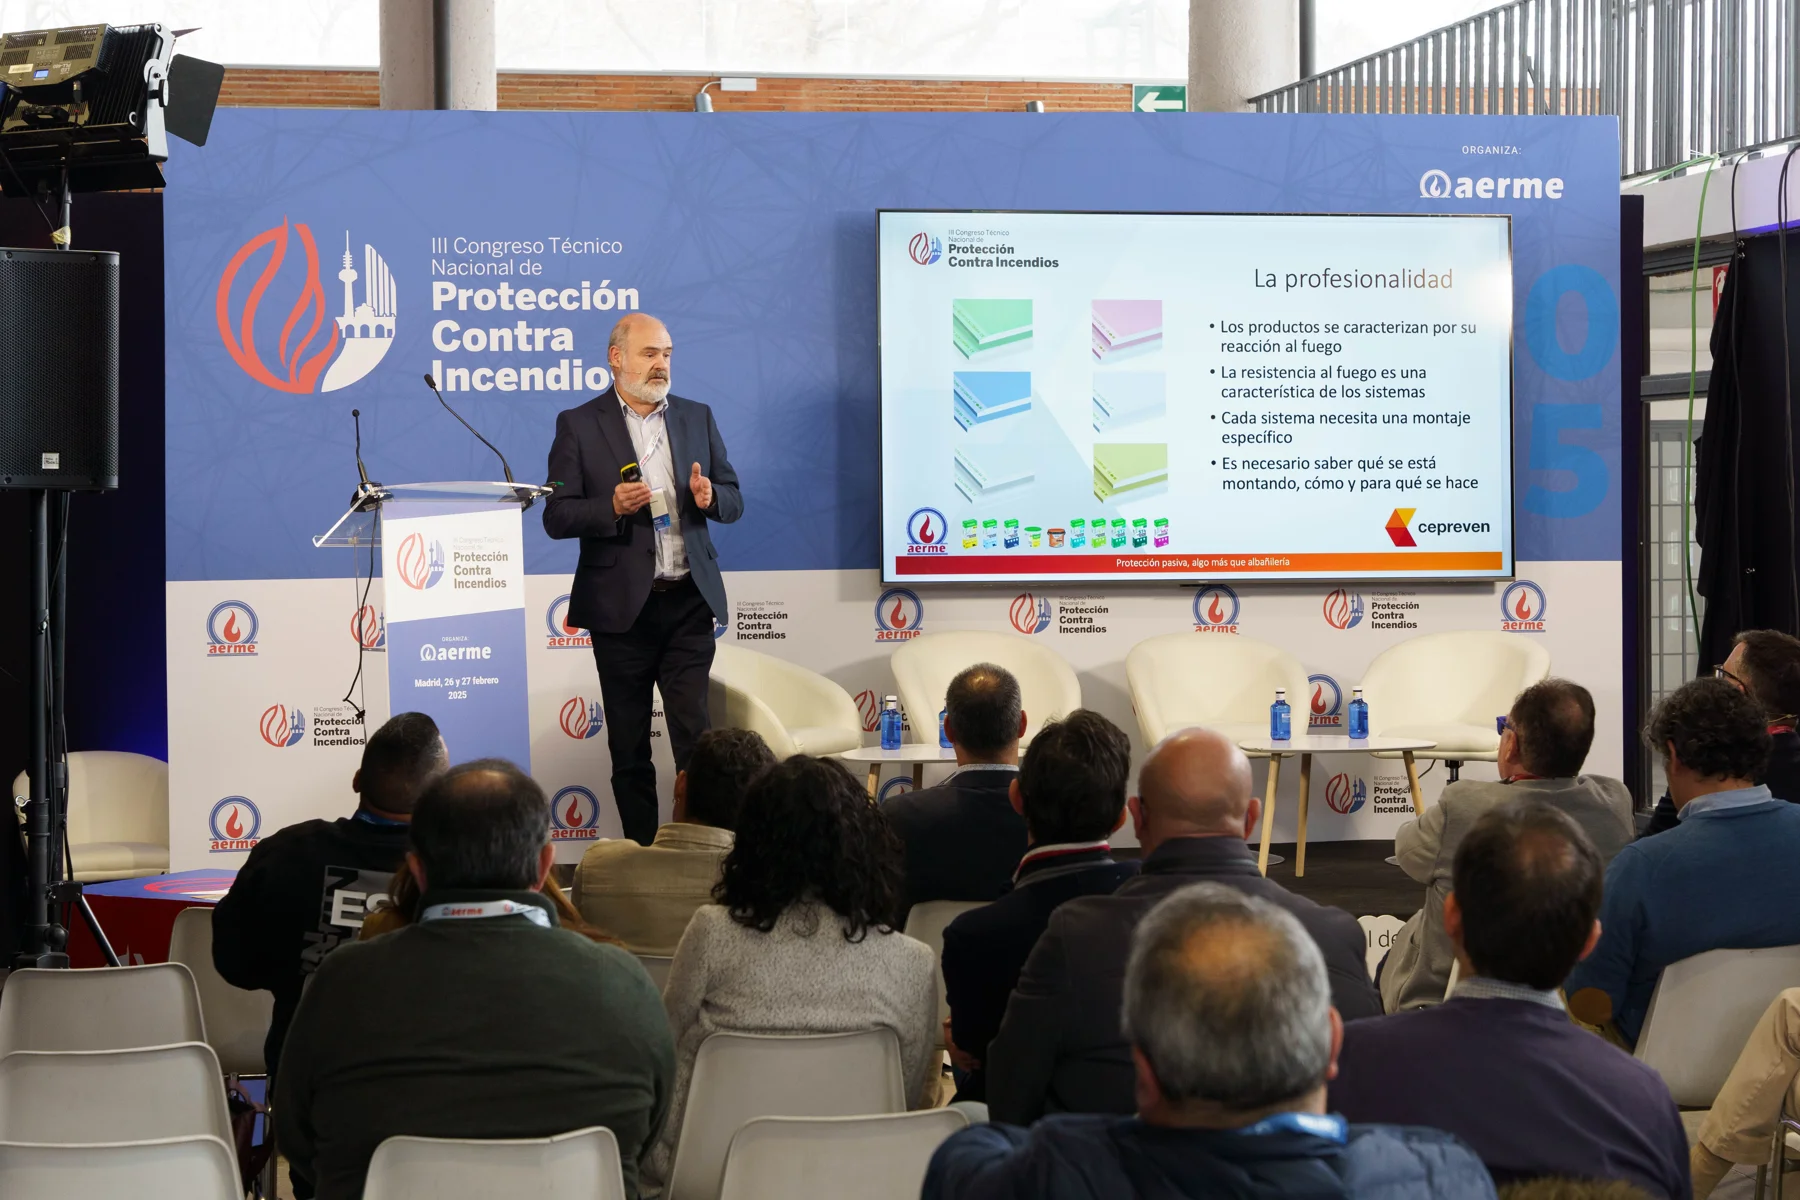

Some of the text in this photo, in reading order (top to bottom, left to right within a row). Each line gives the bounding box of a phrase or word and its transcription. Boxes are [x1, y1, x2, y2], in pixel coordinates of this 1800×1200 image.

[1462, 146, 1522, 154] ORGANIZA:
[1454, 177, 1564, 199] aerme
[432, 236, 623, 257] III Congreso Técnico
[948, 243, 1014, 254] Protección
[432, 259, 542, 275] Nacional de
[948, 257, 1059, 268] Contra Incendios
[1255, 268, 1453, 292] La profesionalidad
[432, 280, 639, 310] Protección
[1221, 320, 1476, 336] Los productos se caracterizan por su
[432, 319, 574, 352] Contra
[1221, 339, 1342, 356] reacción al fuego
[432, 359, 615, 391] Incendio
[1221, 365, 1426, 382] La resistencia al fuego es una
[1221, 385, 1425, 398] característica de los sistemas
[1222, 411, 1471, 427] Cada sistema necesita una montaje
[1222, 430, 1293, 446] específico
[1222, 456, 1436, 472] Es necesario saber qué se está
[1222, 476, 1478, 492] montando, cómo y para qué se hace
[1418, 522, 1490, 536] cepreven
[907, 544, 946, 553] aerme
[454, 550, 508, 562] Protección
[1116, 557, 1290, 568] Protección pasiva, algo más que albañilería
[454, 565, 491, 575] Contra
[454, 578, 506, 589] Incendios
[1060, 605, 1108, 614] Protección
[737, 611, 788, 620] Protección
[1060, 616, 1093, 624] Contra
[1372, 611, 1404, 619] Contra
[737, 622, 772, 630] Contra
[1060, 625, 1107, 633] Incendios
[1195, 624, 1237, 633] aerme
[1372, 620, 1417, 628] Incendios
[1502, 622, 1543, 630] aerme
[737, 631, 786, 640] Incendios
[877, 630, 920, 640] aerme
[549, 637, 592, 646] aerme
[209, 644, 255, 654] aerme
[438, 646, 491, 660] aerme
[415, 679, 442, 688] Madrid,
[473, 676, 499, 684] febrero
[448, 691, 467, 699] 2025
[1309, 716, 1339, 724] erme
[314, 728, 350, 736] Contra
[314, 737, 365, 746] Incendios
[1374, 805, 1415, 813] Incendio
[552, 828, 596, 838] aerme
[211, 839, 258, 849] aerme
